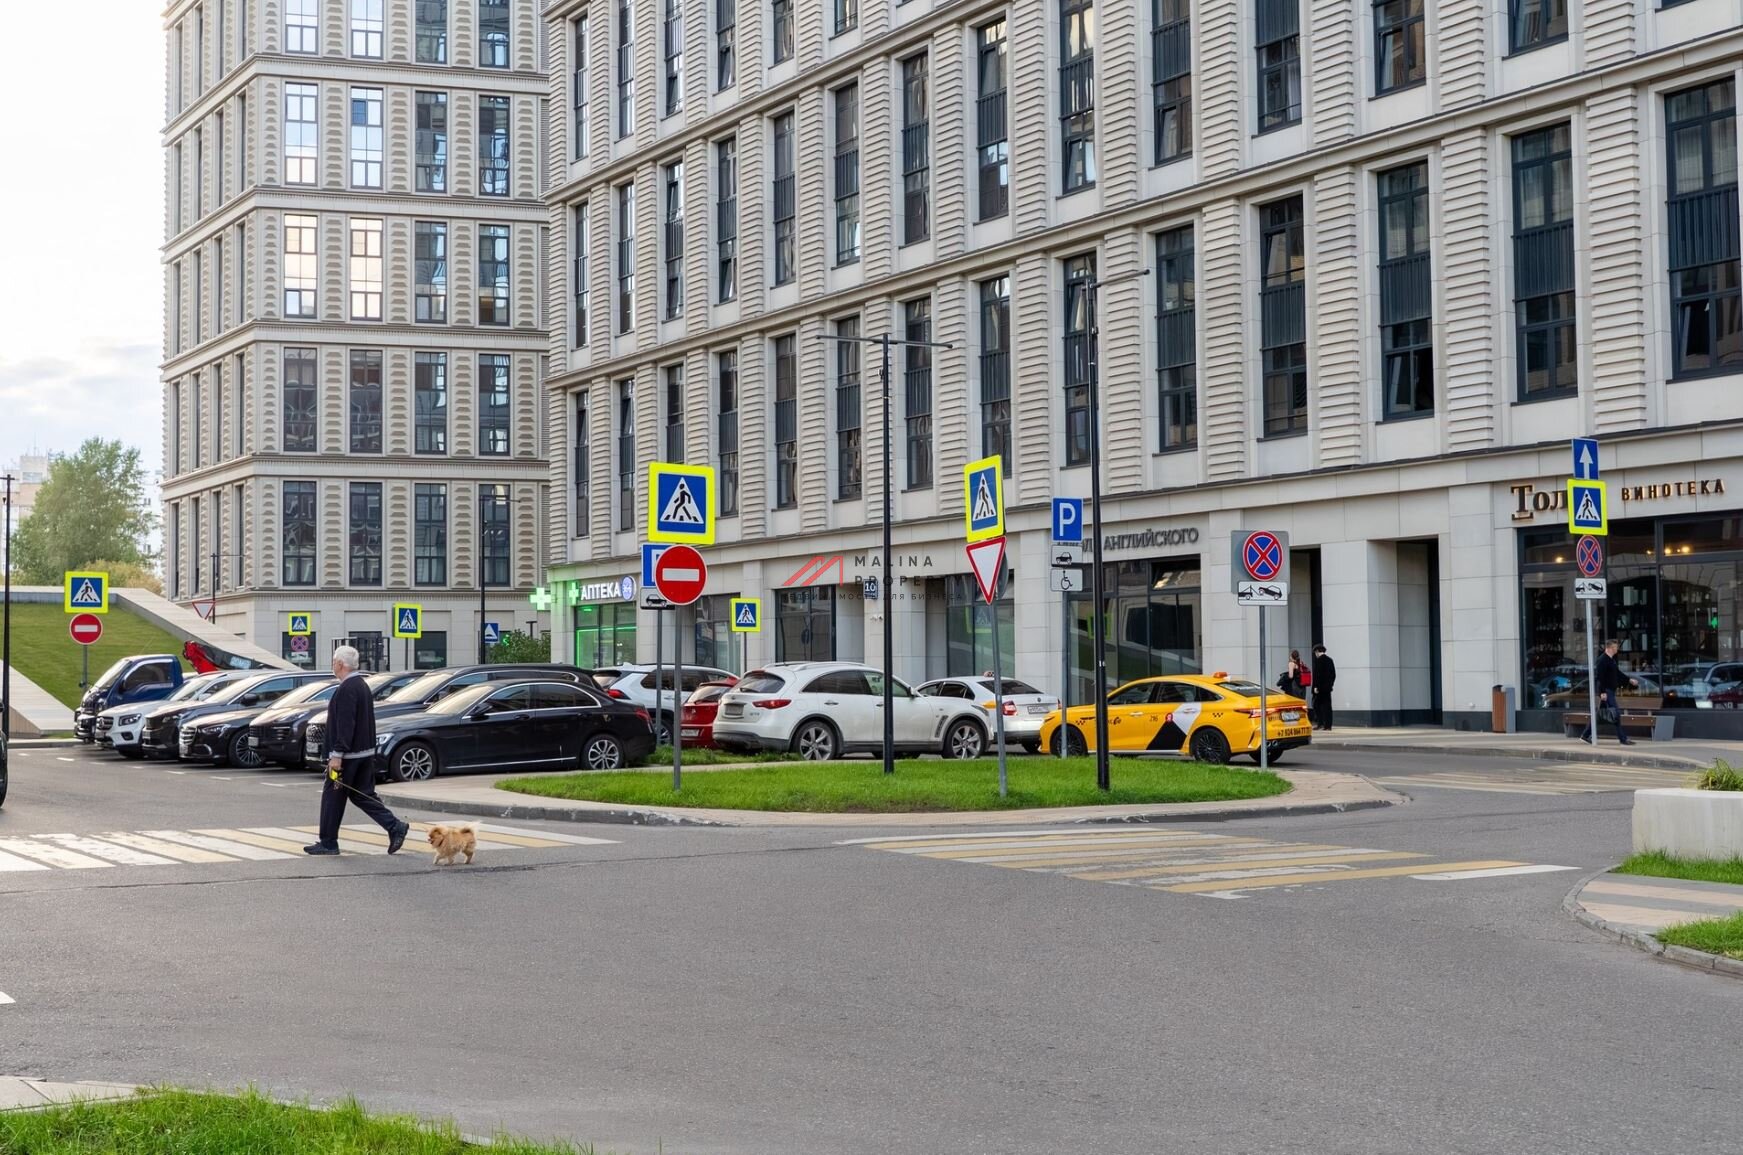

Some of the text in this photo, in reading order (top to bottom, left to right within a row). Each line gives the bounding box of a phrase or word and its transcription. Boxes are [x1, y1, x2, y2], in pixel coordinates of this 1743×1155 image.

[1510, 479, 1725, 521] Тол ВИНОТЕКА
[1059, 502, 1076, 537] P
[1104, 528, 1199, 550] АНГЛИЙСКОГО
[581, 582, 621, 600] АПТЕКА
[865, 582, 876, 592] 10
